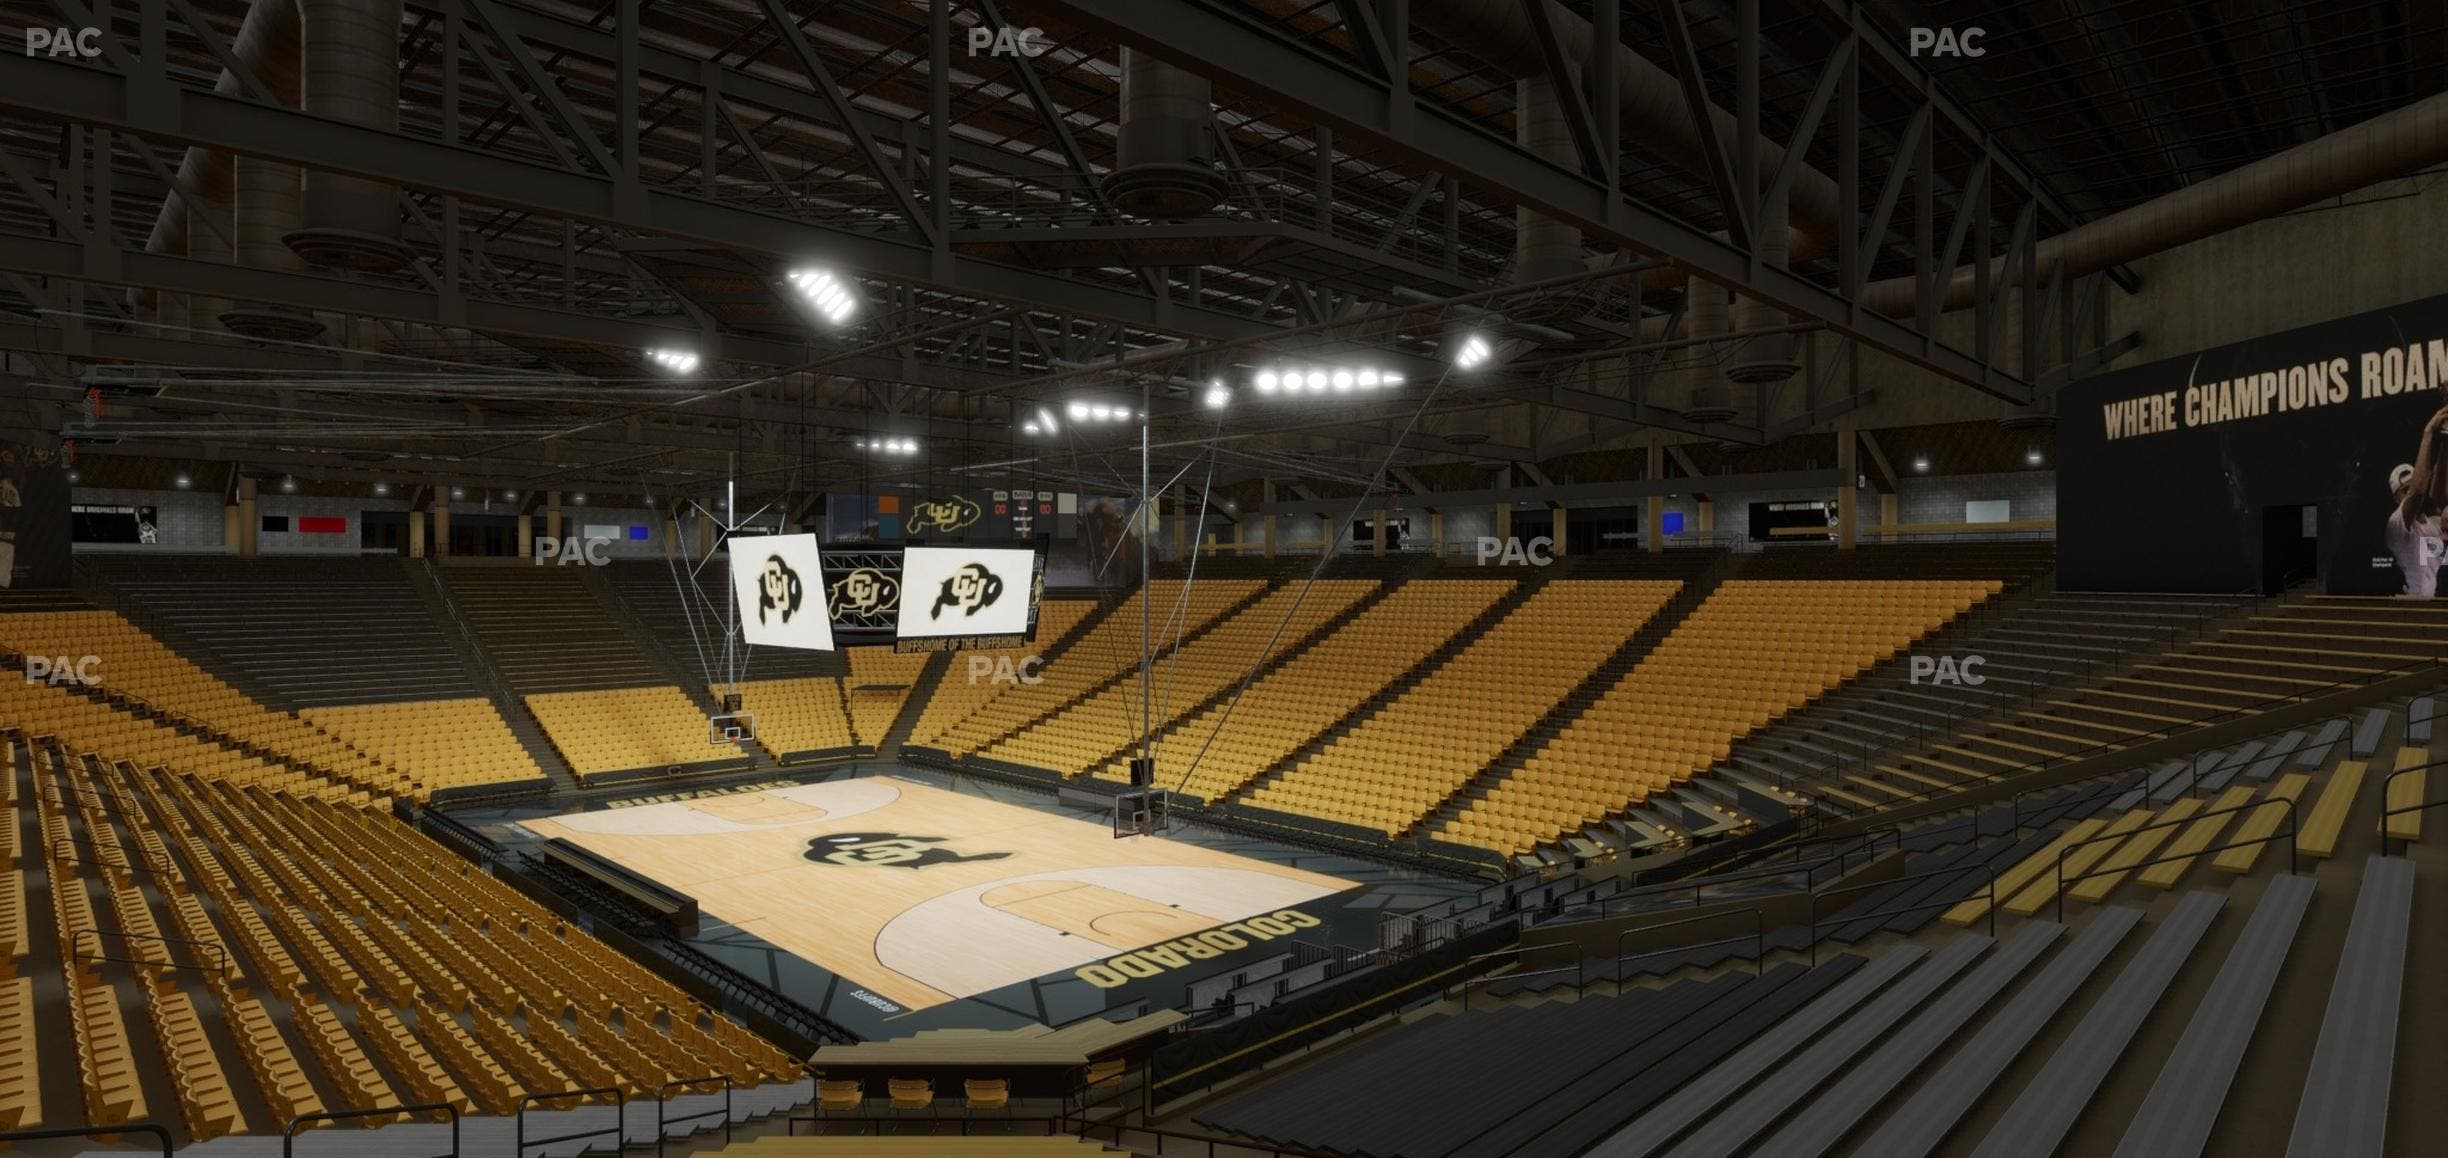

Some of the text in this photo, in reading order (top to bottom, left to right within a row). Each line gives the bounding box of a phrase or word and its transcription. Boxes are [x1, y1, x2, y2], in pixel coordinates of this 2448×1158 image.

[2104, 391, 2177, 440] WHERE
[2184, 357, 2349, 428] CHAMPIONS
[607, 779, 800, 809] BUFFALOES
[1075, 909, 1322, 988] COLORADO
